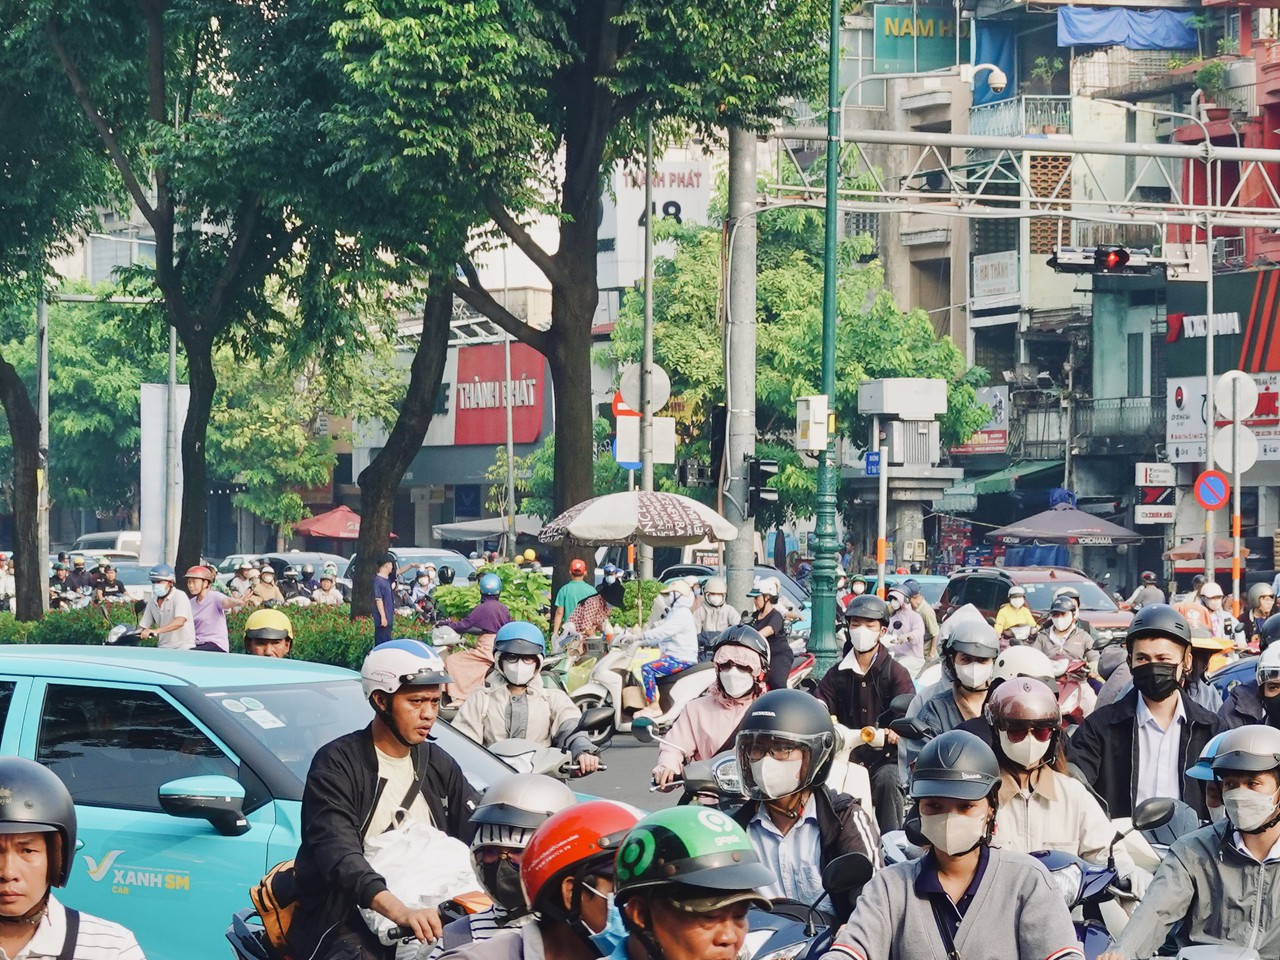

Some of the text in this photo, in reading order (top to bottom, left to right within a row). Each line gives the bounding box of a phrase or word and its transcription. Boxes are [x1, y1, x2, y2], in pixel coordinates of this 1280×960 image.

[884, 17, 934, 37] NAM
[669, 169, 702, 188] PHÁT
[1183, 312, 1240, 338] YOKOAMA
[457, 376, 500, 409] THÀNH
[113, 870, 190, 890] XANH SM
[112, 886, 128, 895] CAR
